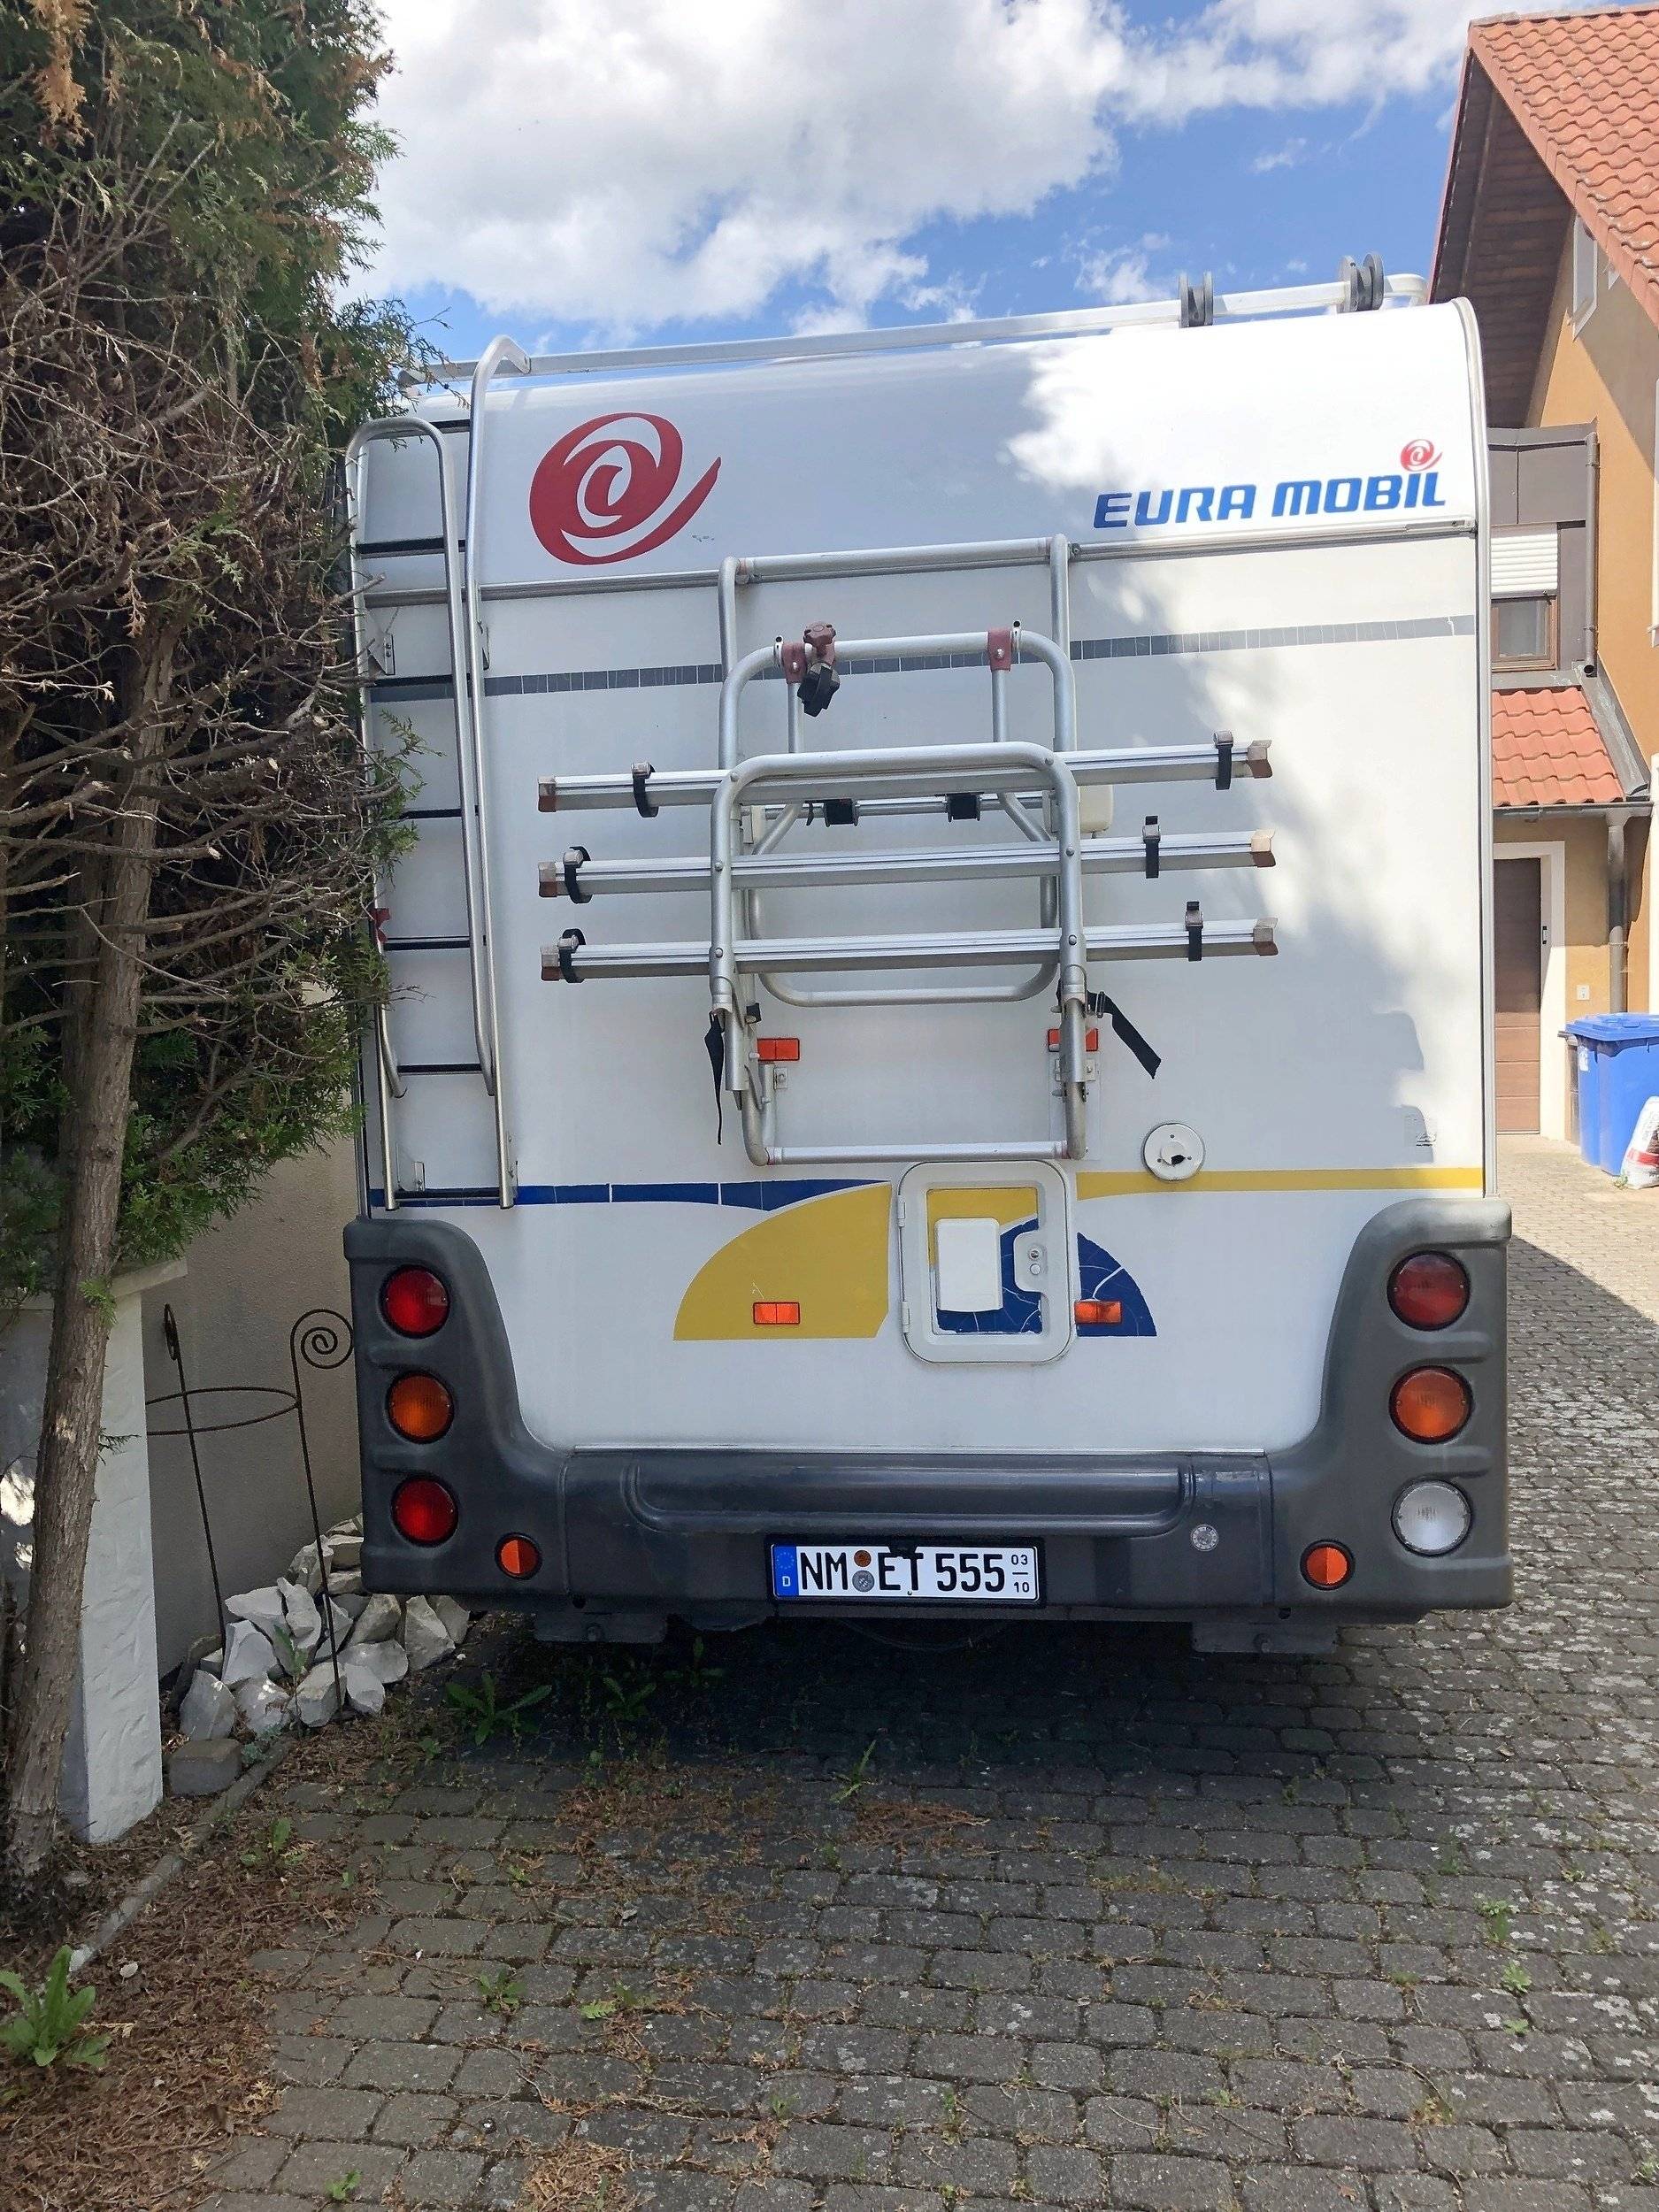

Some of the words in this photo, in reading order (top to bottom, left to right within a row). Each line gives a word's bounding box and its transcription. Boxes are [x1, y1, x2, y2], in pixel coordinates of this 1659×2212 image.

[1094, 484, 1256, 529] EURA
[1271, 472, 1447, 517] MOBIL
[1010, 1554, 1028, 1565] 03
[800, 1552, 849, 1590] NM
[878, 1552, 924, 1591] ET
[934, 1554, 1005, 1592] 555
[782, 1576, 791, 1586] D
[1013, 1582, 1030, 1593] 10
